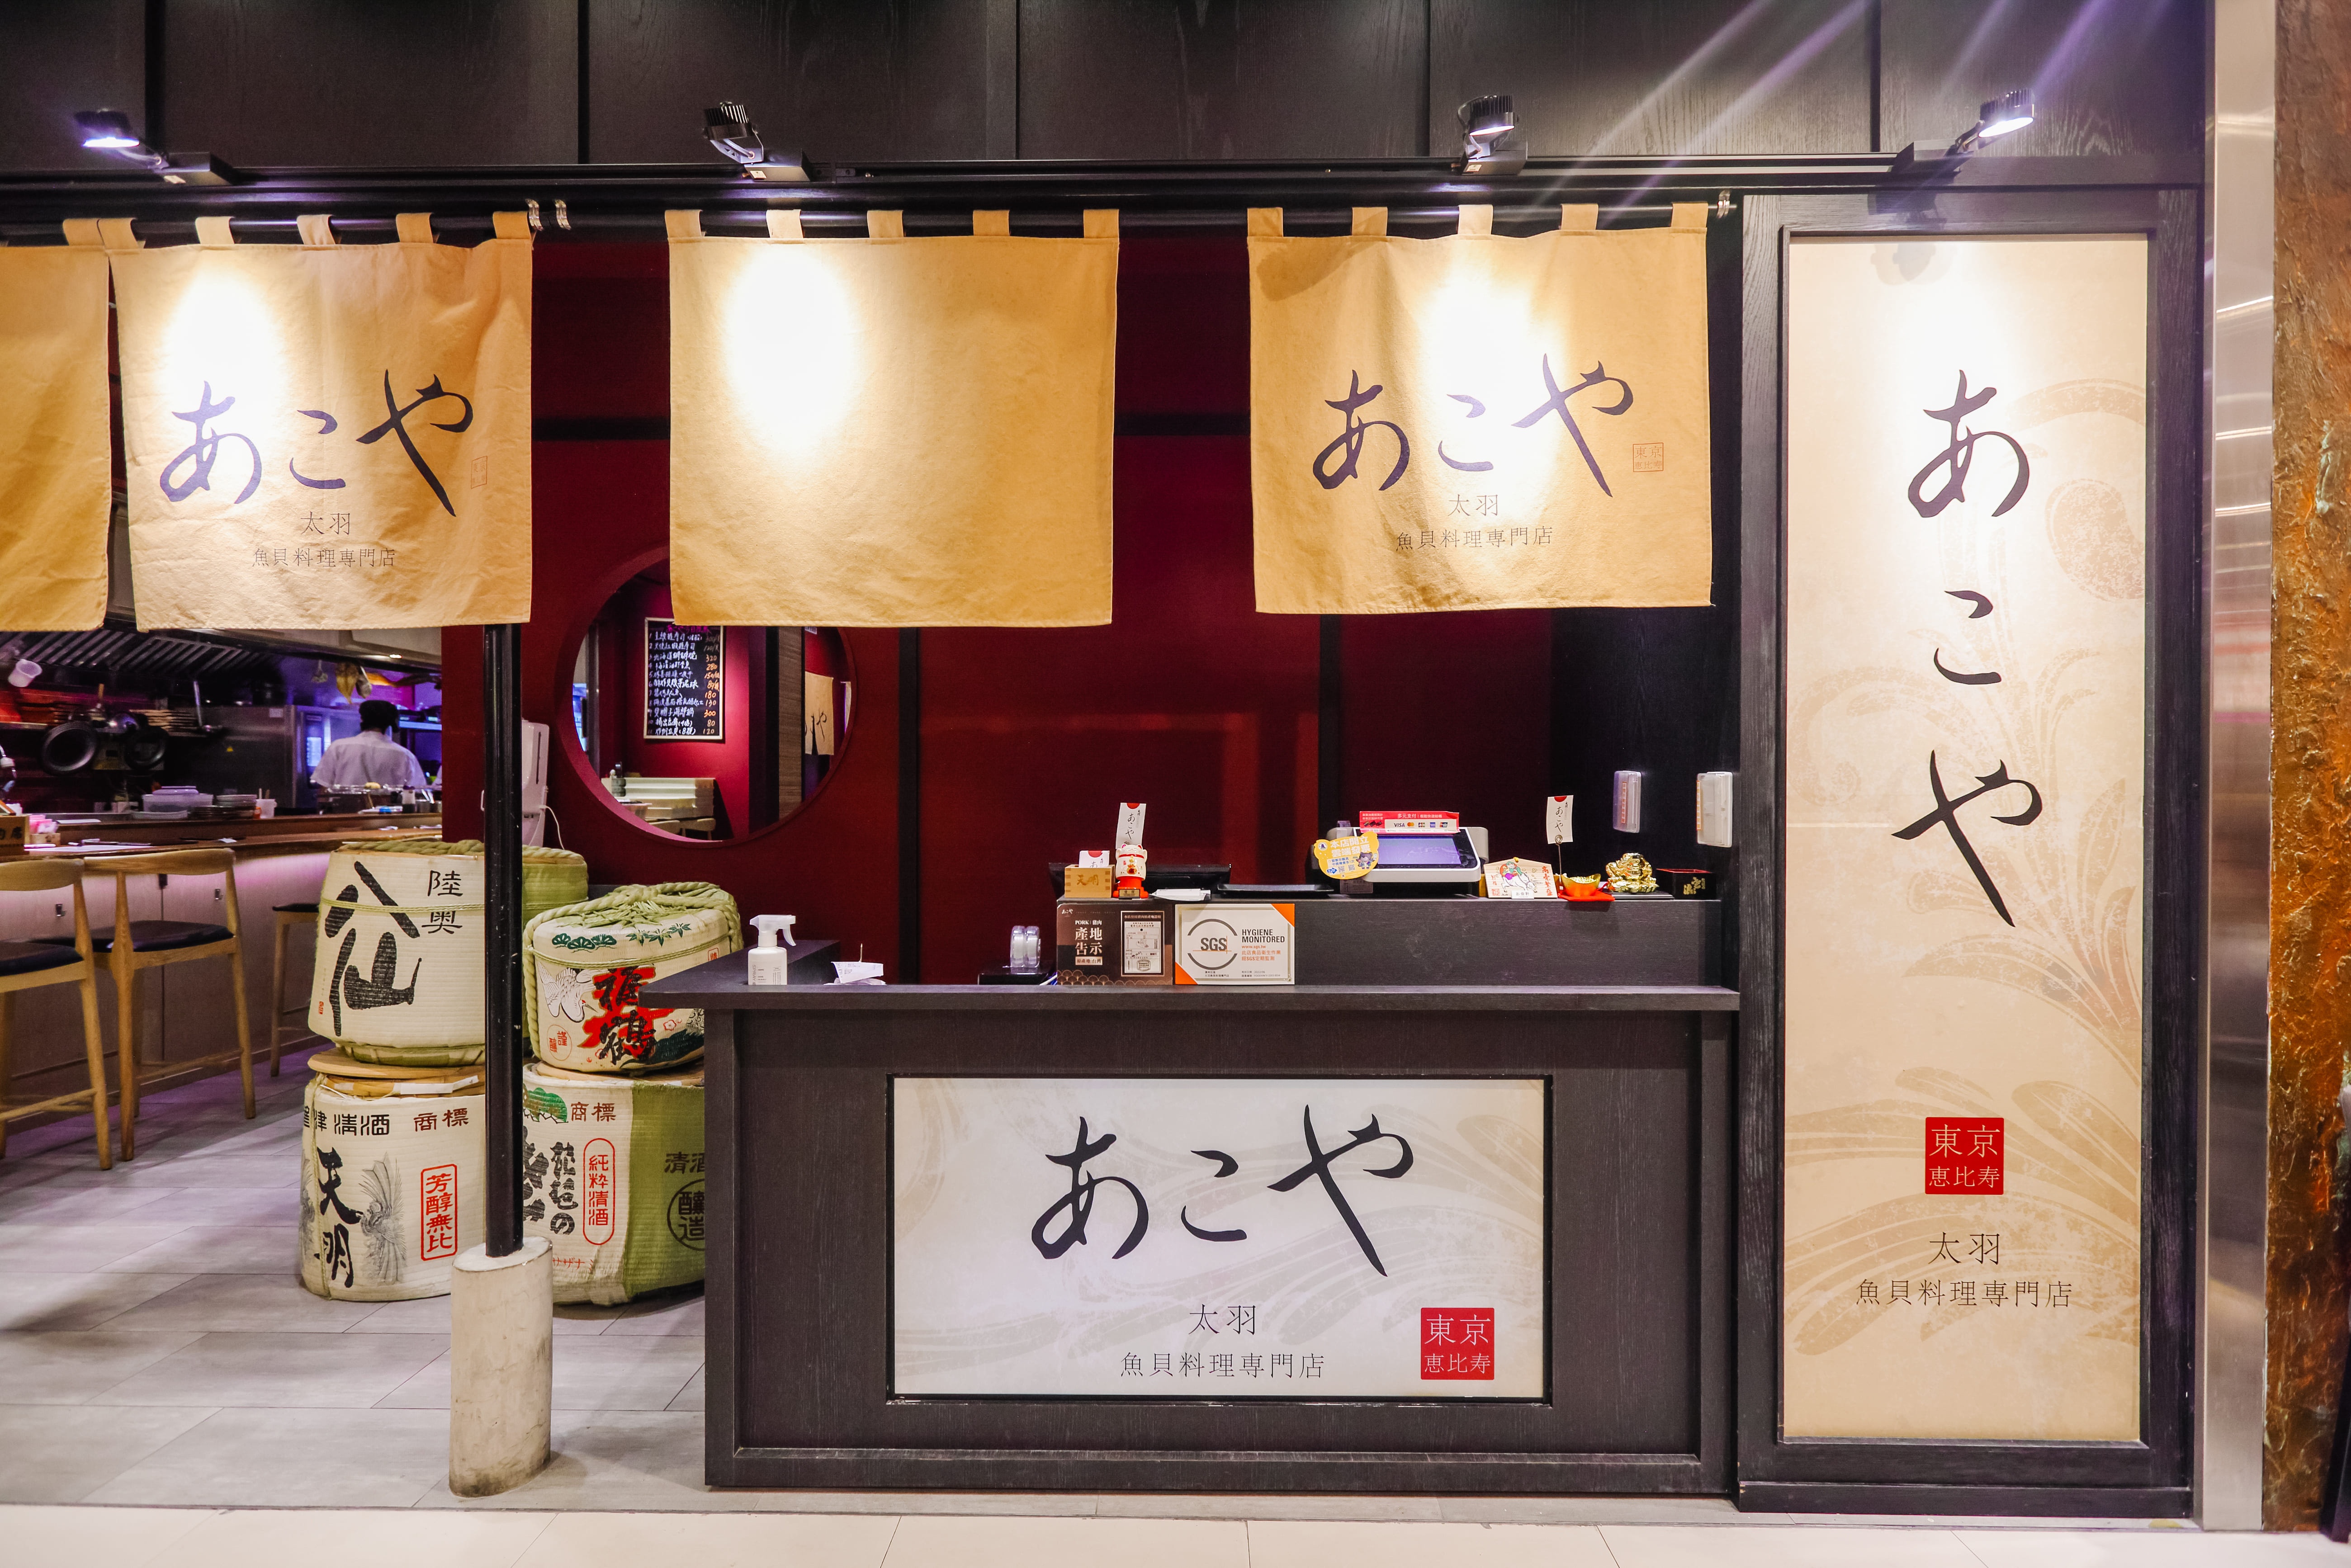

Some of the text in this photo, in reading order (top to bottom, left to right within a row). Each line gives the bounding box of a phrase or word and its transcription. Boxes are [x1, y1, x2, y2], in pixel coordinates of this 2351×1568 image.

[1313, 353, 1634, 497] あこや
[160, 368, 473, 518] あこや
[1635, 446, 1662, 459] 東京
[1447, 493, 1499, 517] 太羽
[300, 510, 352, 536] 太羽
[1395, 525, 1554, 553] 魚貝料理専門店
[251, 548, 396, 569] 魚貝料理専門店
[1891, 369, 2043, 928] あこや
[705, 690, 717, 699] 180
[704, 709, 716, 718] 300
[1125, 813, 1135, 840] あこや
[1555, 806, 1563, 832] あこや
[1330, 836, 1369, 848] 本店開立
[1331, 844, 1371, 858] 雲端發票
[1075, 927, 1102, 940] 產地
[1201, 937, 1227, 951] SGS
[325, 861, 422, 1037] 八仙
[1075, 942, 1102, 955] 告示
[414, 1108, 468, 1132] 商標
[571, 1102, 617, 1122] 商標
[1929, 1124, 2001, 1158] 東京
[1929, 1166, 2000, 1188] 恵比寿
[1031, 1104, 1414, 1277] あこや
[426, 1173, 453, 1252] 芳醇無比
[1928, 1232, 2000, 1265] 太羽
[1856, 1279, 2072, 1308] 魚貝料理専門店
[1188, 1303, 1257, 1336] 太羽
[1424, 1314, 1491, 1346] 東京
[1120, 1351, 1325, 1379] 魚貝料理専門店
[1424, 1352, 1491, 1374] 恵比寿
